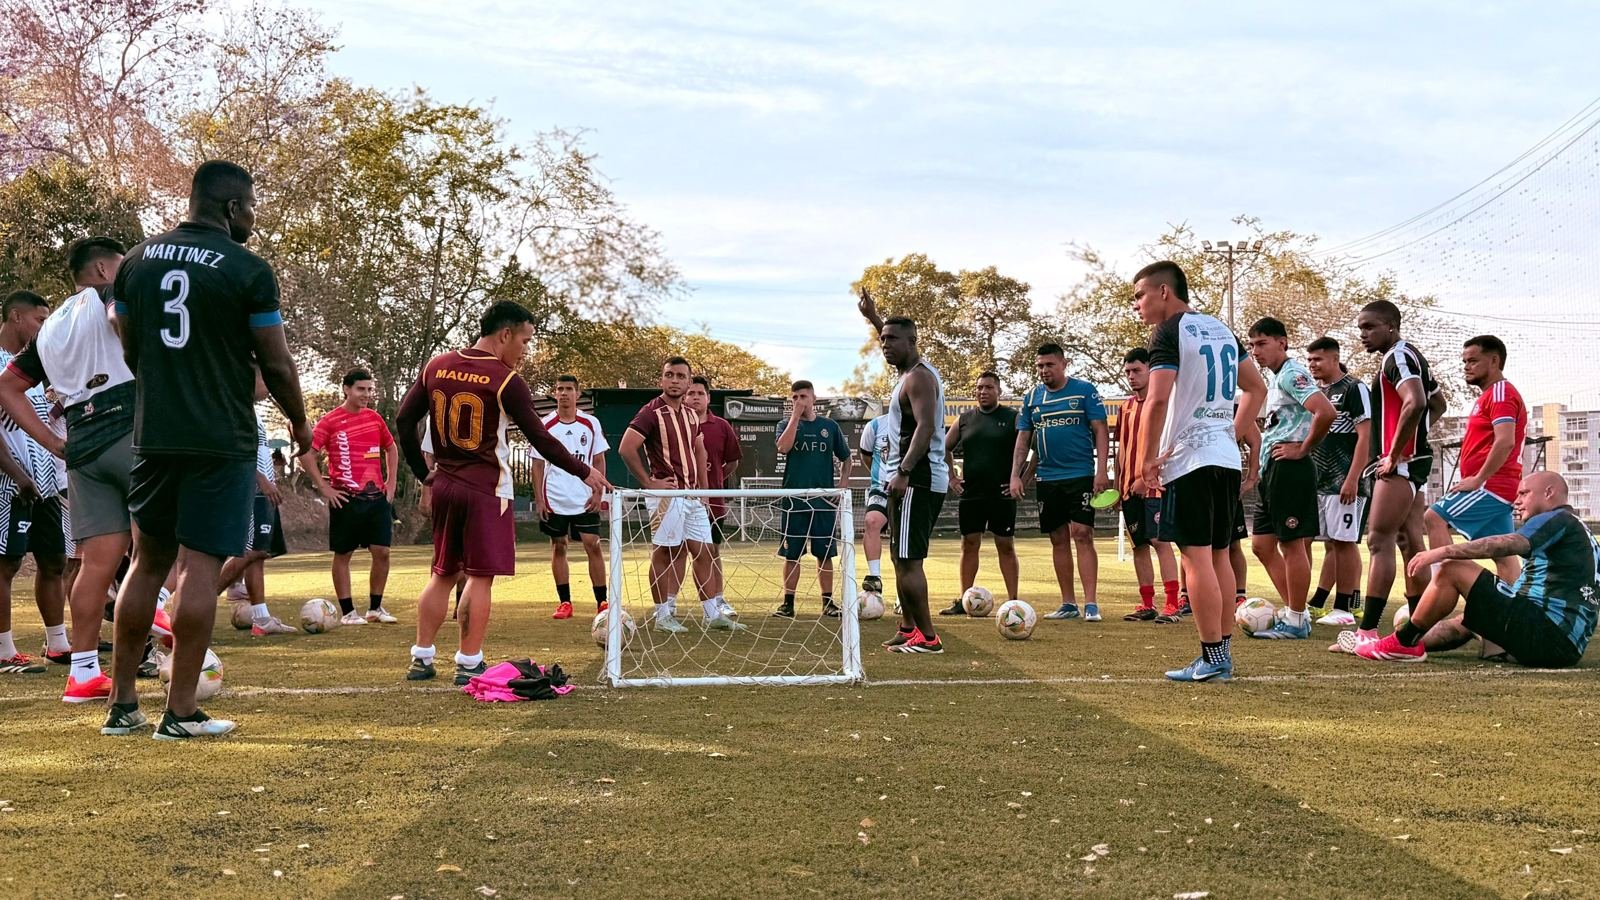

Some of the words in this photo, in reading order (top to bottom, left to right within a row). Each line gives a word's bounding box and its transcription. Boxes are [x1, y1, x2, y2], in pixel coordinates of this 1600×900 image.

[142, 243, 225, 268] MARTINEZ
[160, 269, 190, 349] 3
[435, 369, 491, 384] MAURO
[1199, 344, 1236, 402] 16
[432, 389, 485, 451] 10
[740, 425, 775, 433] RENDIMIENTO
[336, 430, 360, 488] Valencia
[1343, 513, 1353, 529] 9
